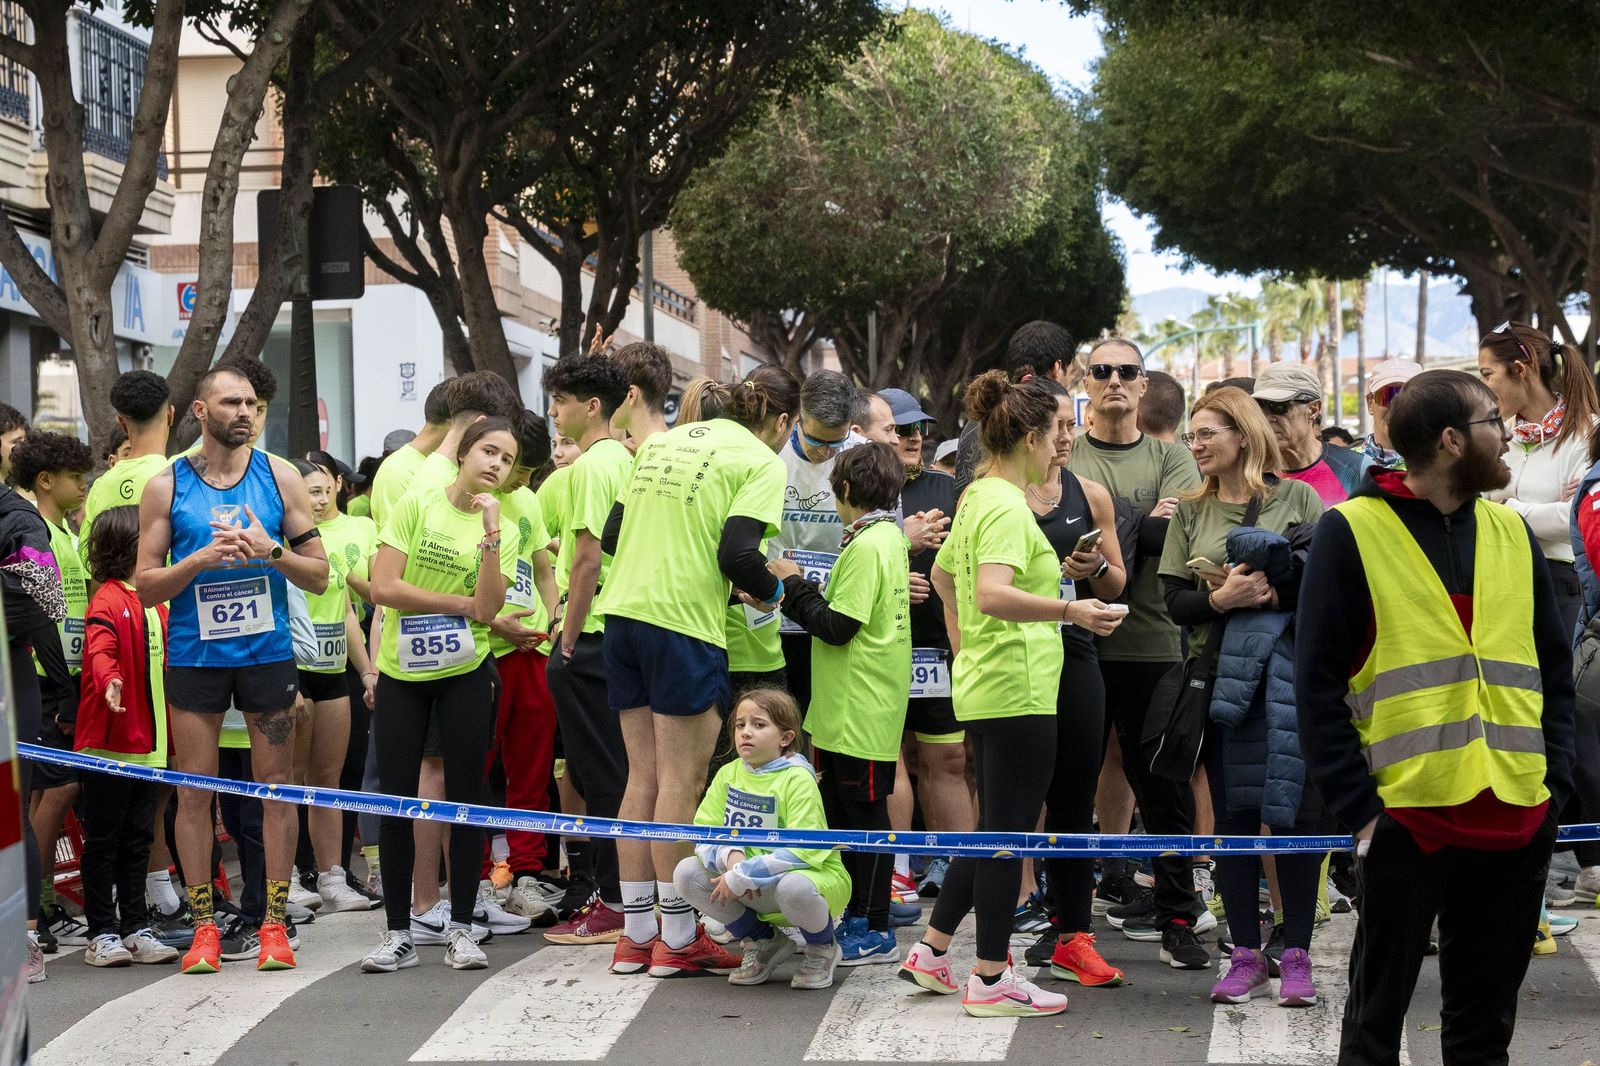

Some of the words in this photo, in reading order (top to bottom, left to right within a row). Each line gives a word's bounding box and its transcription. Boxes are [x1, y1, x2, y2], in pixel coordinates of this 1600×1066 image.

[428, 541, 460, 556] Almería
[428, 550, 454, 561] marcha
[416, 555, 438, 565] contra
[446, 562, 469, 573] cáncer
[814, 560, 834, 568] cánce
[206, 592, 226, 600] contra
[233, 588, 254, 597] cáncer
[208, 585, 231, 593] Almería
[212, 599, 258, 624] 621
[410, 633, 461, 657] 855
[911, 666, 939, 684] 91
[181, 775, 242, 793] Ayuntamiento
[331, 798, 393, 813] Ayuntamiento
[739, 801, 761, 810] cáncer
[485, 815, 547, 829] Ayuntamiento
